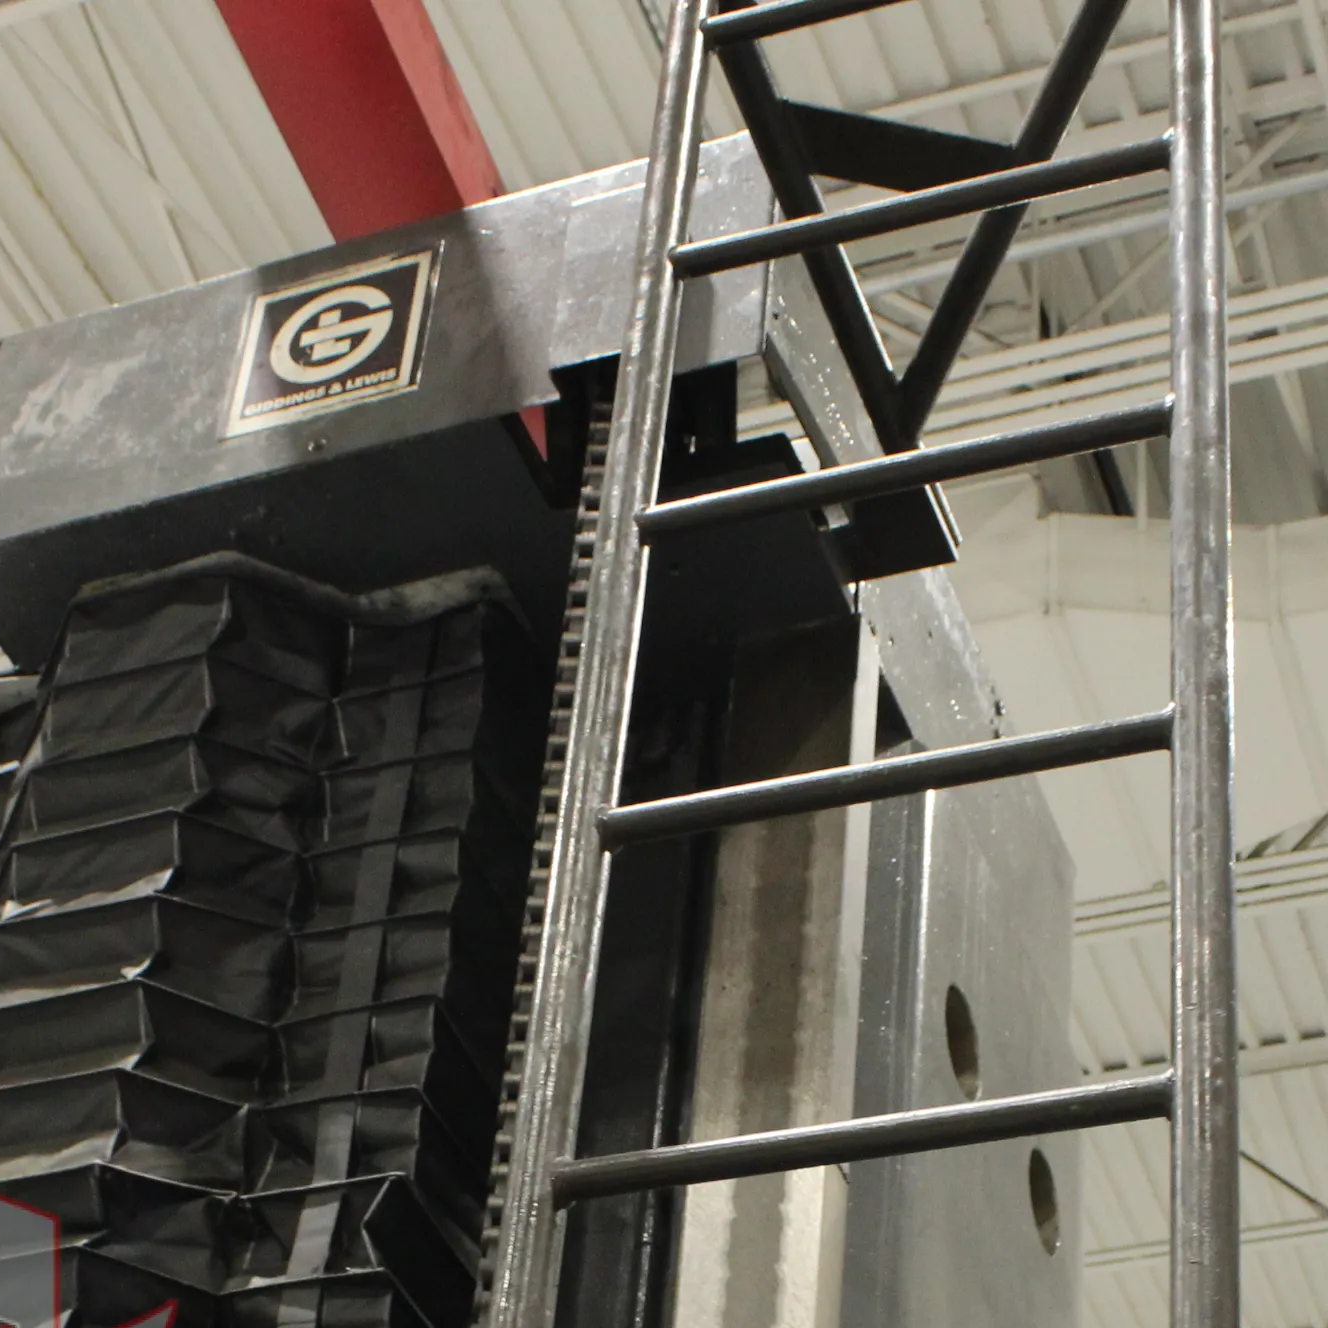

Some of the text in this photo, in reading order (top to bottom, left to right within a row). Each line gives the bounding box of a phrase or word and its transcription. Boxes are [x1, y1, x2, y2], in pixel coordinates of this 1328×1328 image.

[243, 368, 397, 416] GIDDINGS & LEWIS
